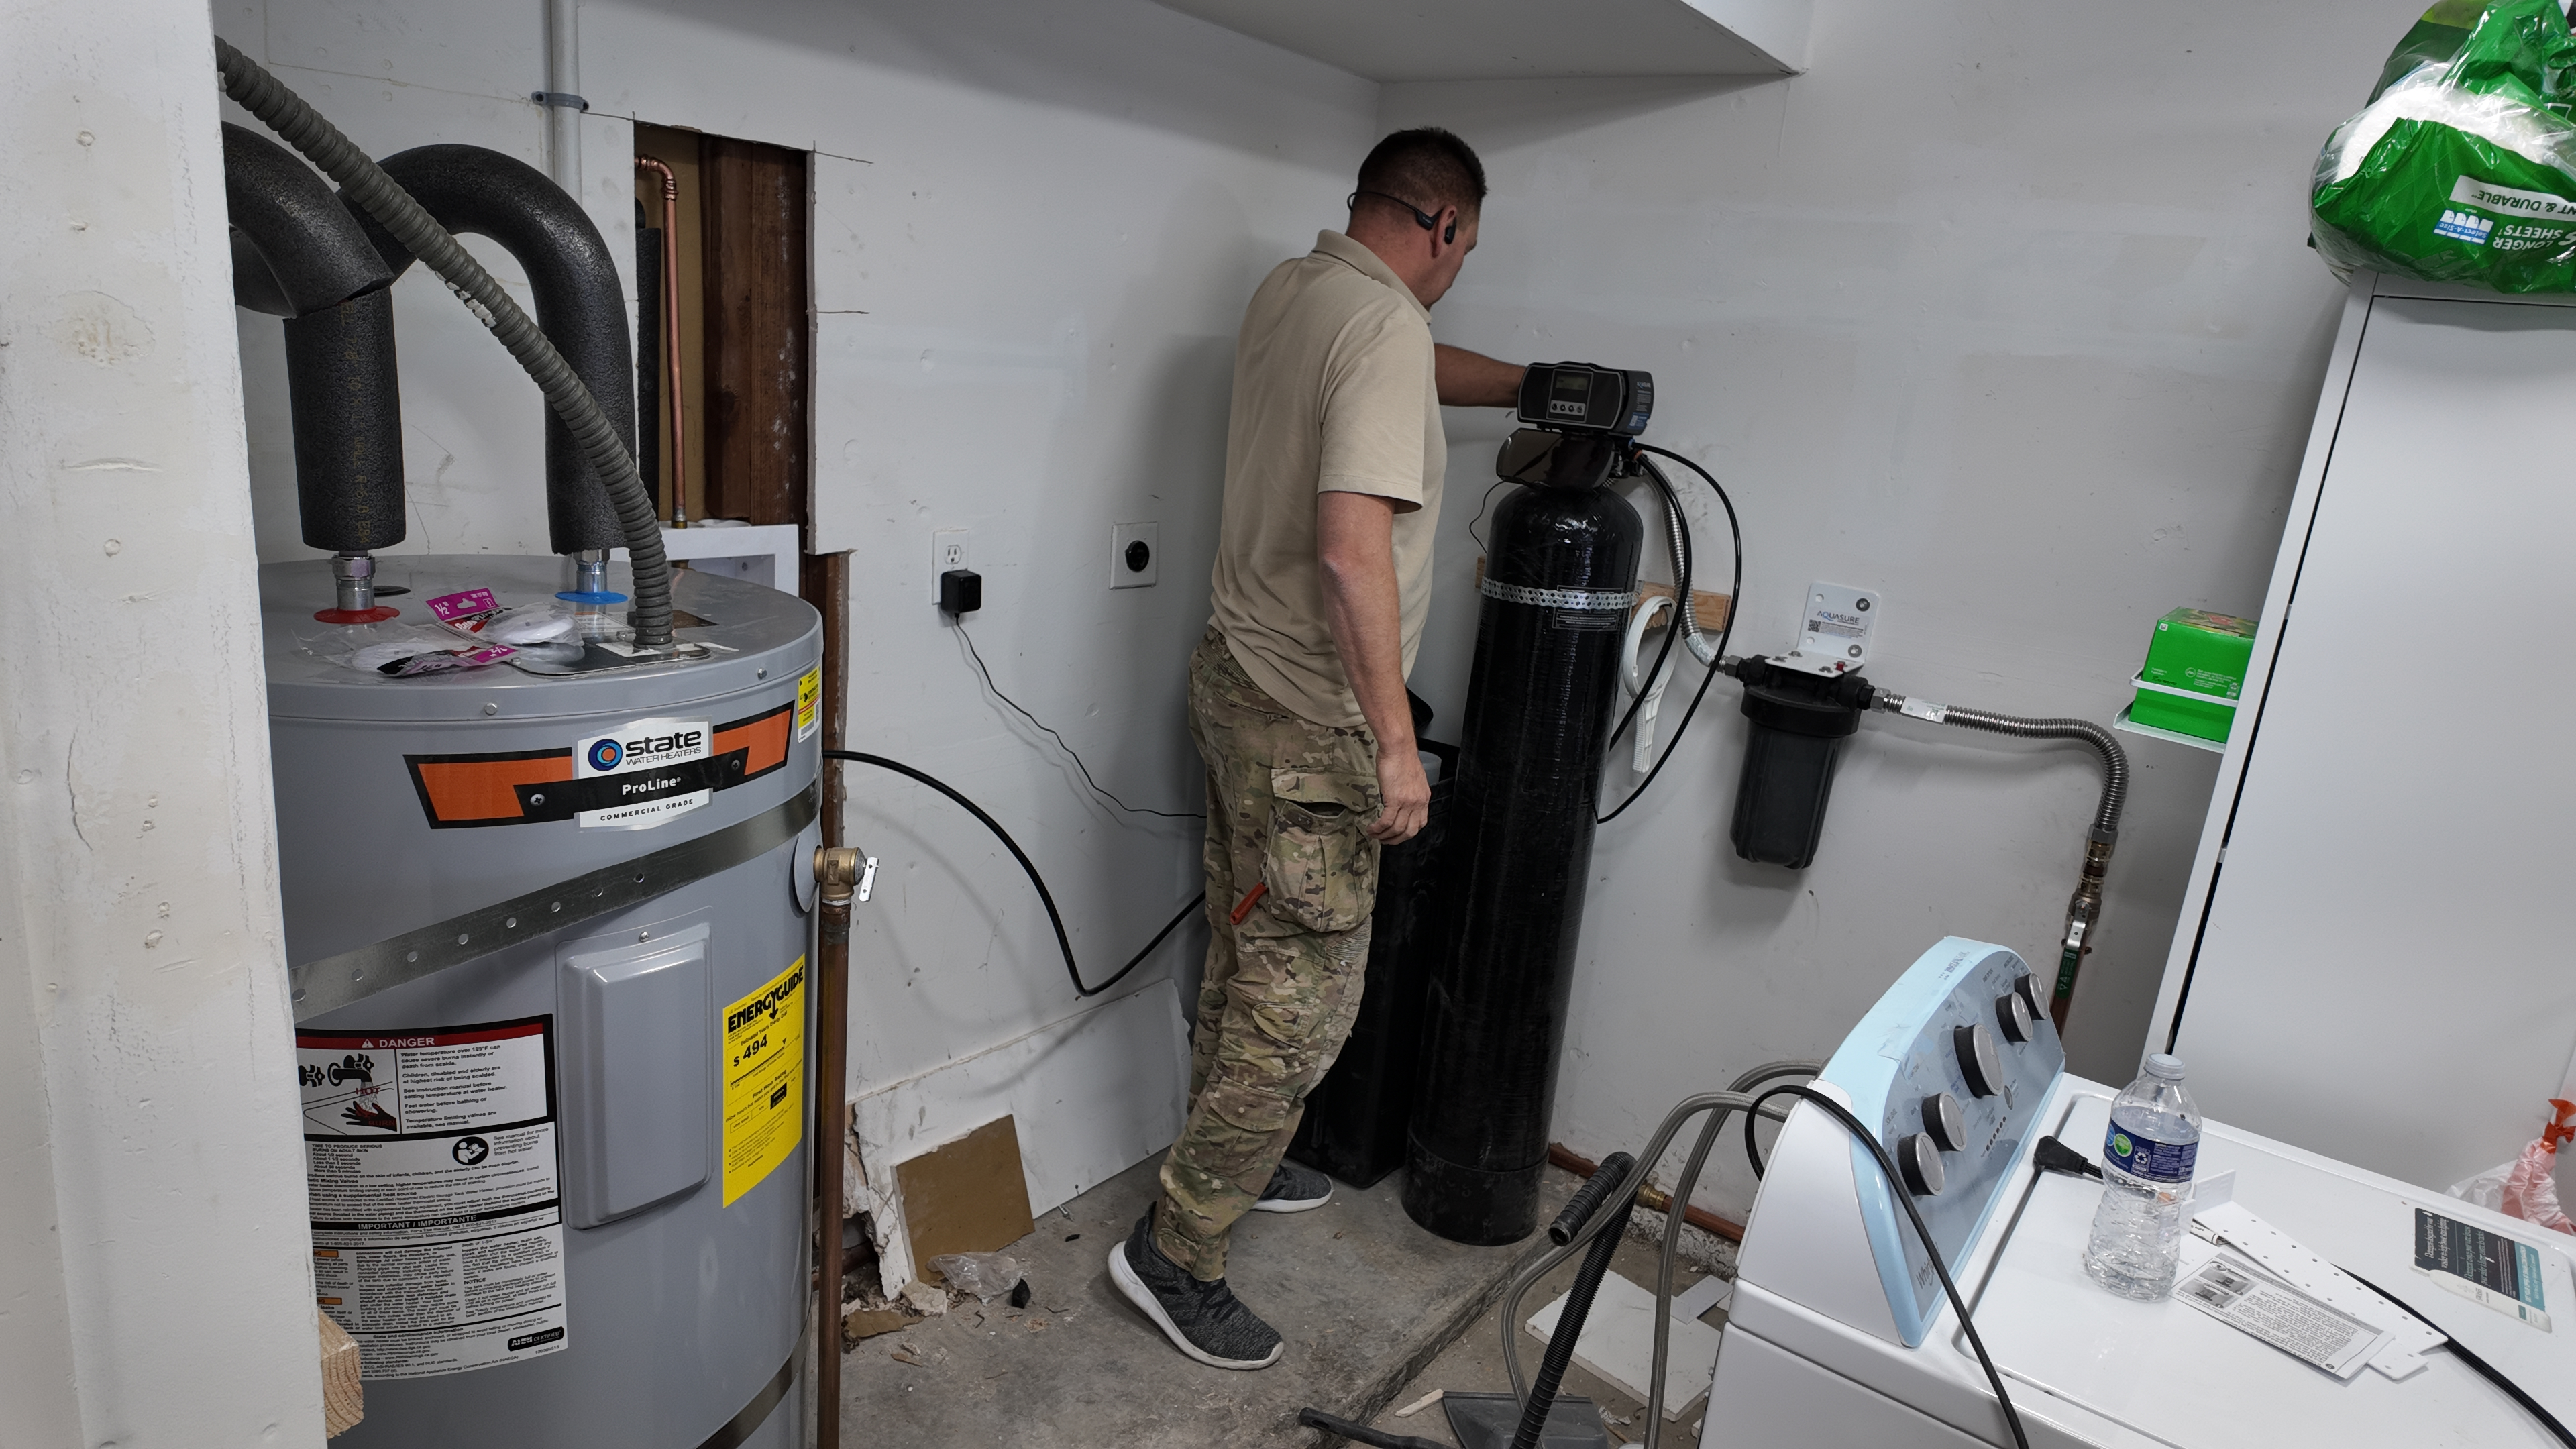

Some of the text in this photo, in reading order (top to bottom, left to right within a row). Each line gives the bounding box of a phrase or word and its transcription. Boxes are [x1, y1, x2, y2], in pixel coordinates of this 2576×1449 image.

[2544, 202, 2557, 213] &
[2438, 223, 2487, 239] Select-A-Size
[2492, 237, 2554, 250] LONGER
[1817, 610, 1860, 624] AQUASURE
[625, 729, 702, 759] state
[625, 745, 702, 767] WATER HEATERS
[600, 798, 694, 822] COMMERCIAL GRADE
[728, 965, 804, 1034] ENERGYGUIDE
[379, 1037, 435, 1049] DANGER
[743, 1034, 767, 1059] 494
[355, 1087, 381, 1095] HOT
[358, 1220, 411, 1230] IMPORTANT
[417, 1215, 477, 1228] IMPORTANTE
